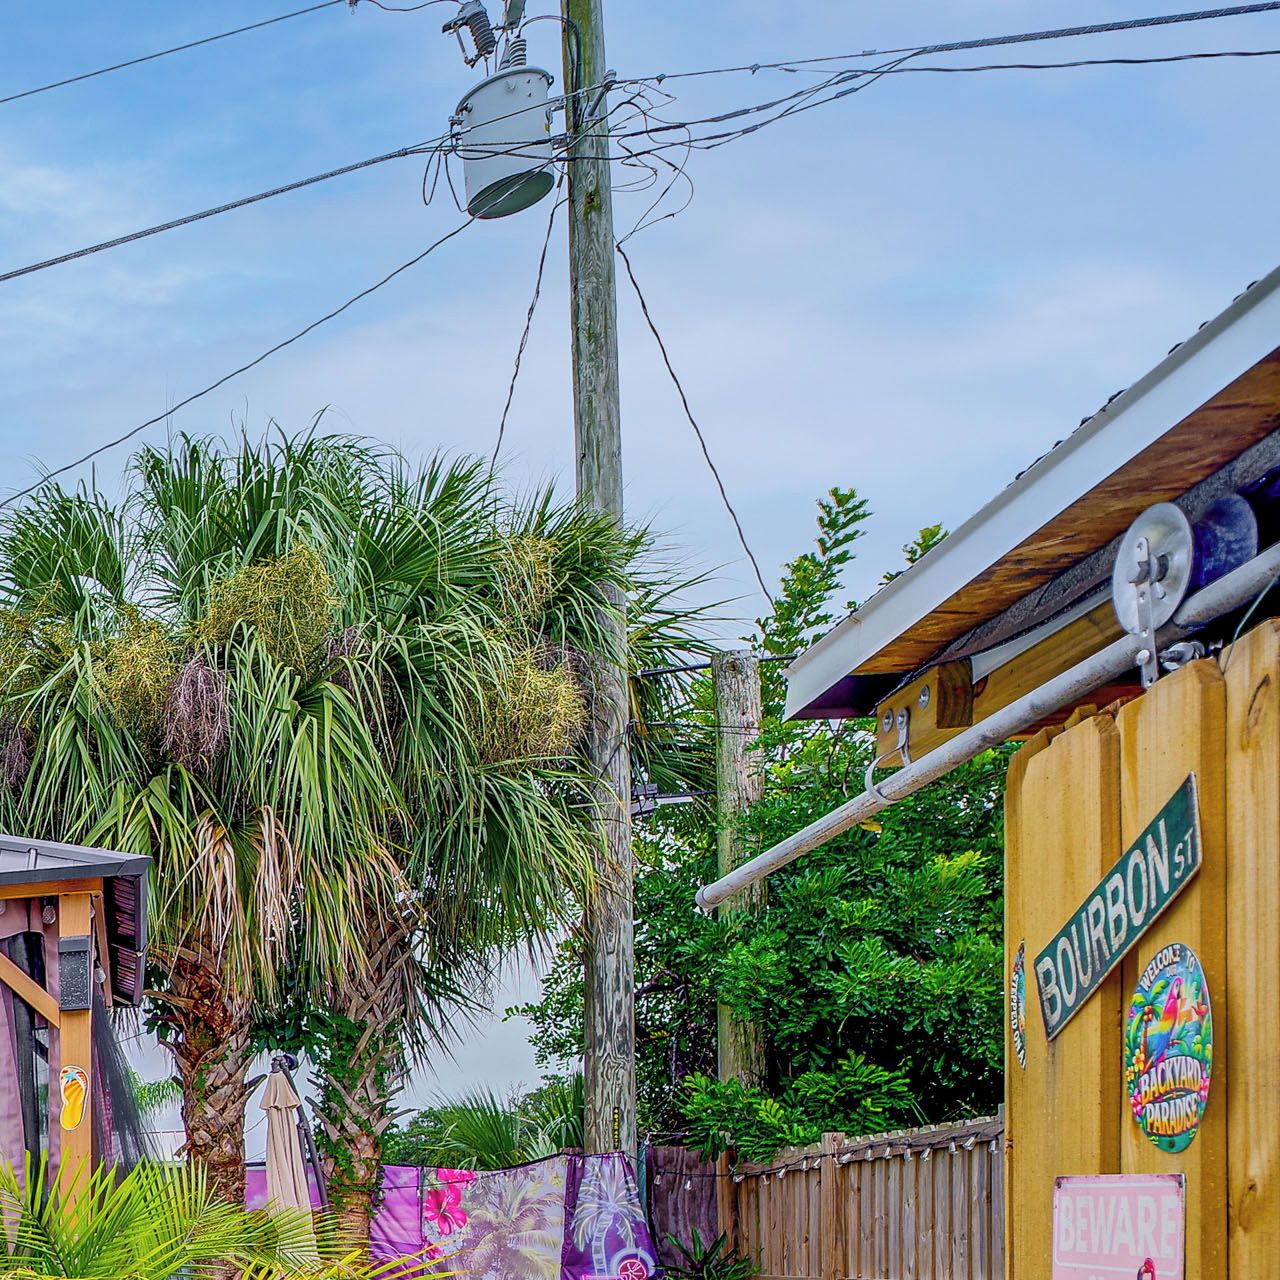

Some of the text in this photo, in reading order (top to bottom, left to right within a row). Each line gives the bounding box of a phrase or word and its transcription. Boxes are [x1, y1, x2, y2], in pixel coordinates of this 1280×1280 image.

[1037, 818, 1194, 1025] BOURBON ST
[1140, 944, 1196, 991] WELCOME TO
[1011, 971, 1019, 1030] STEPPED
[1139, 1056, 1201, 1105] BACKYARD
[1146, 1095, 1199, 1134] PARADISE
[1060, 1195, 1178, 1258] BEWARE
